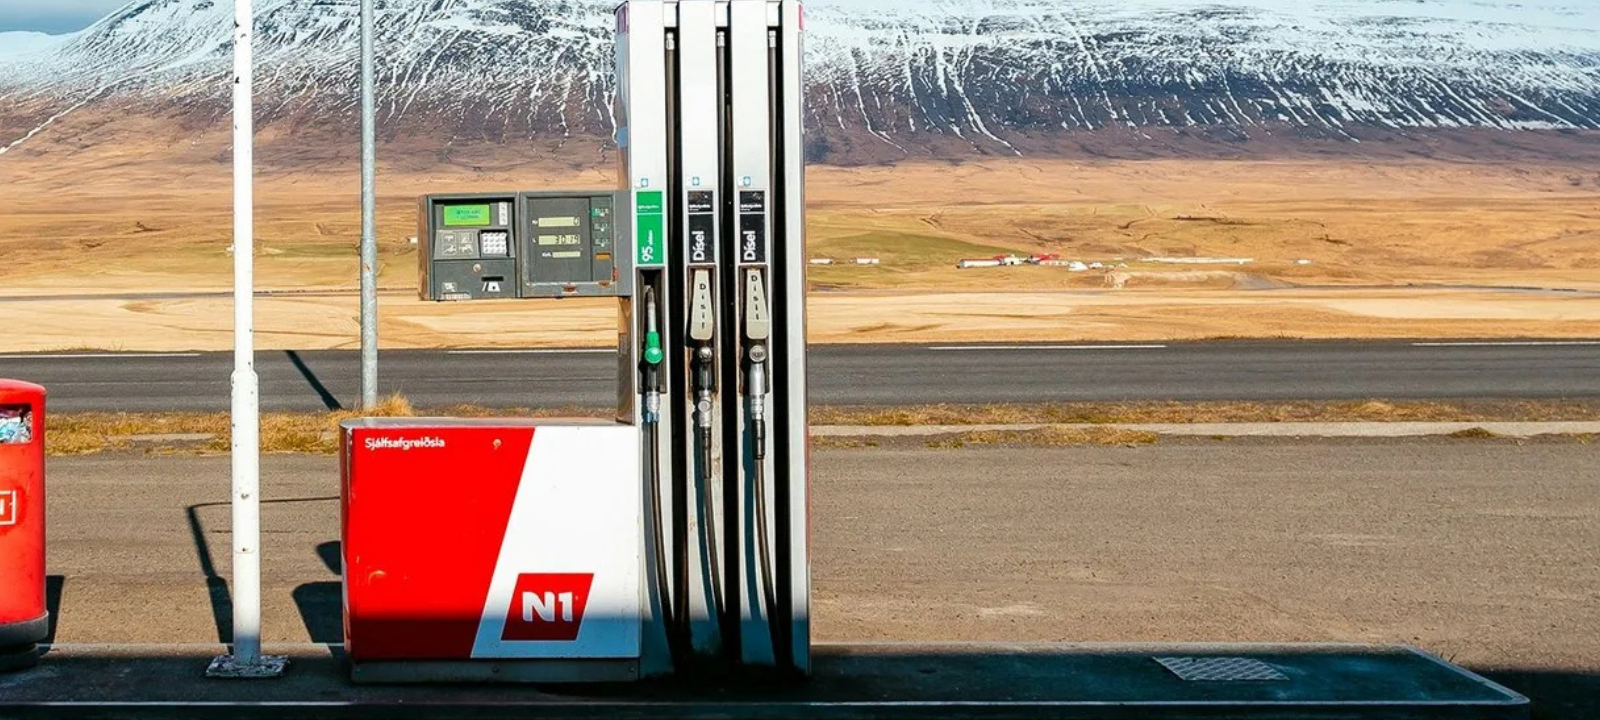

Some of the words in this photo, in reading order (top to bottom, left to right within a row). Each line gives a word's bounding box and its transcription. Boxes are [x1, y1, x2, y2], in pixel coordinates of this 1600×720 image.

[642, 246, 653, 262] 95
[692, 230, 705, 261] Dísel
[742, 230, 756, 261] Dísel
[522, 591, 573, 622] N1
